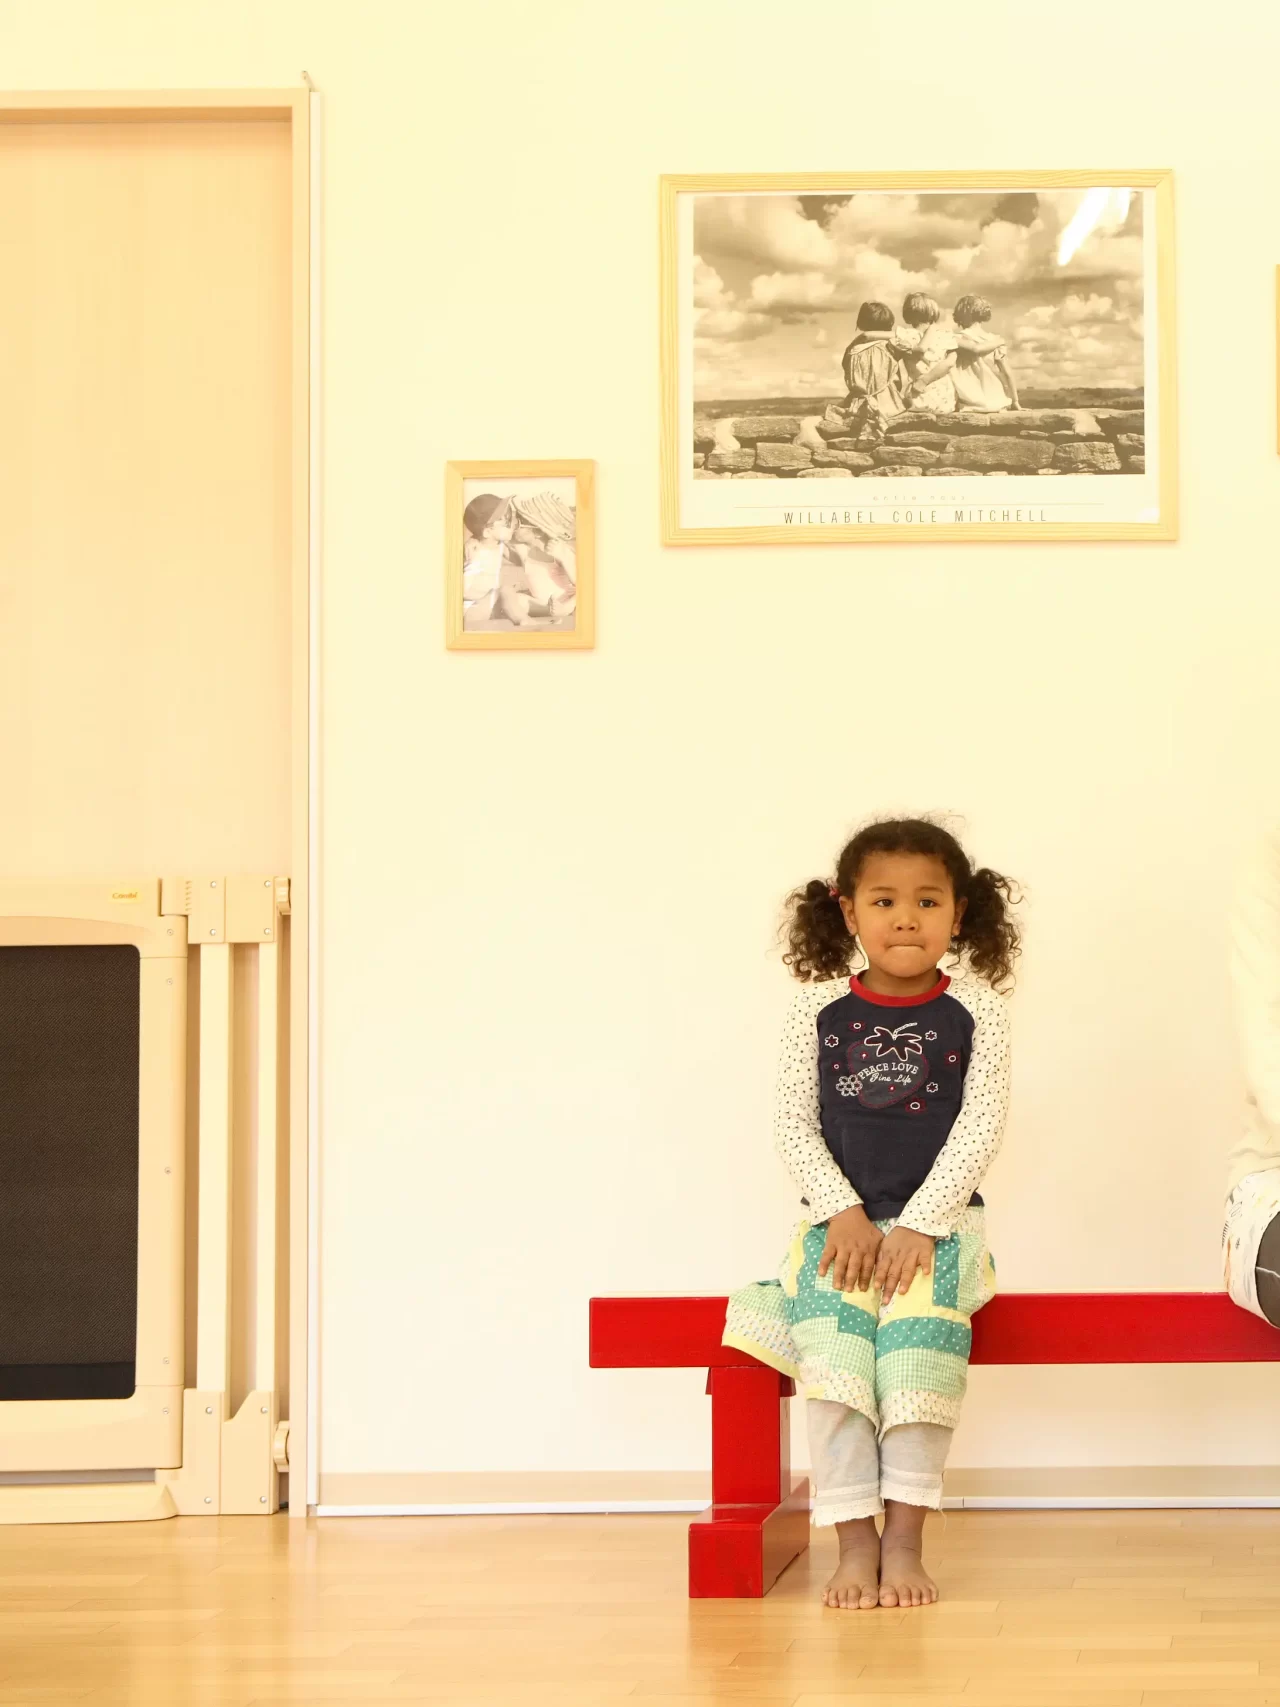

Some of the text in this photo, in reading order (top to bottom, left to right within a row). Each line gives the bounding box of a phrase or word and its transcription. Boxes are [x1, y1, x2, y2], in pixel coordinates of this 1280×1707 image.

[784, 509, 1047, 524] WILLABEL COLE MITCHELL
[857, 1062, 919, 1080] PEACE LOVE
